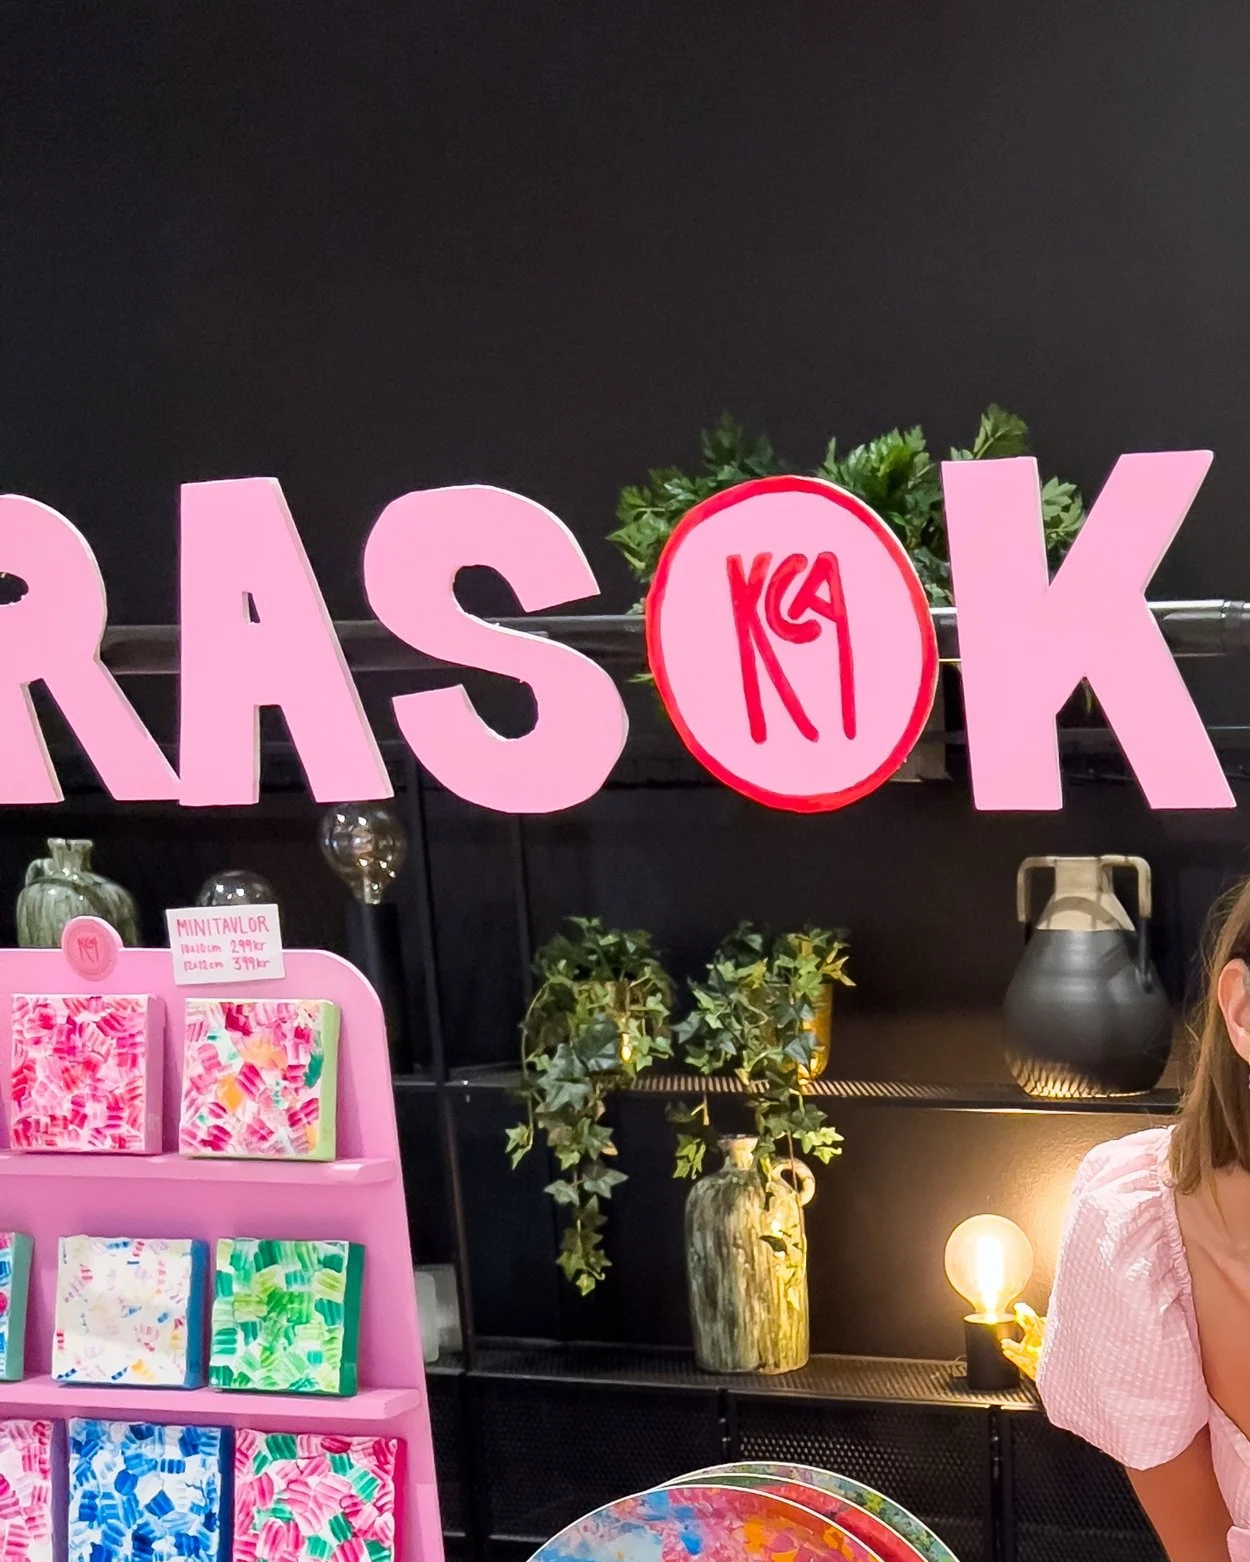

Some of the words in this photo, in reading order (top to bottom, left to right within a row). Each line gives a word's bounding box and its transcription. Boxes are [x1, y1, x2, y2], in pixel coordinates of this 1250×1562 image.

[176, 915, 270, 937] MINITAVLOR
[230, 939, 266, 953] 299kr
[232, 956, 270, 971] 399kr
